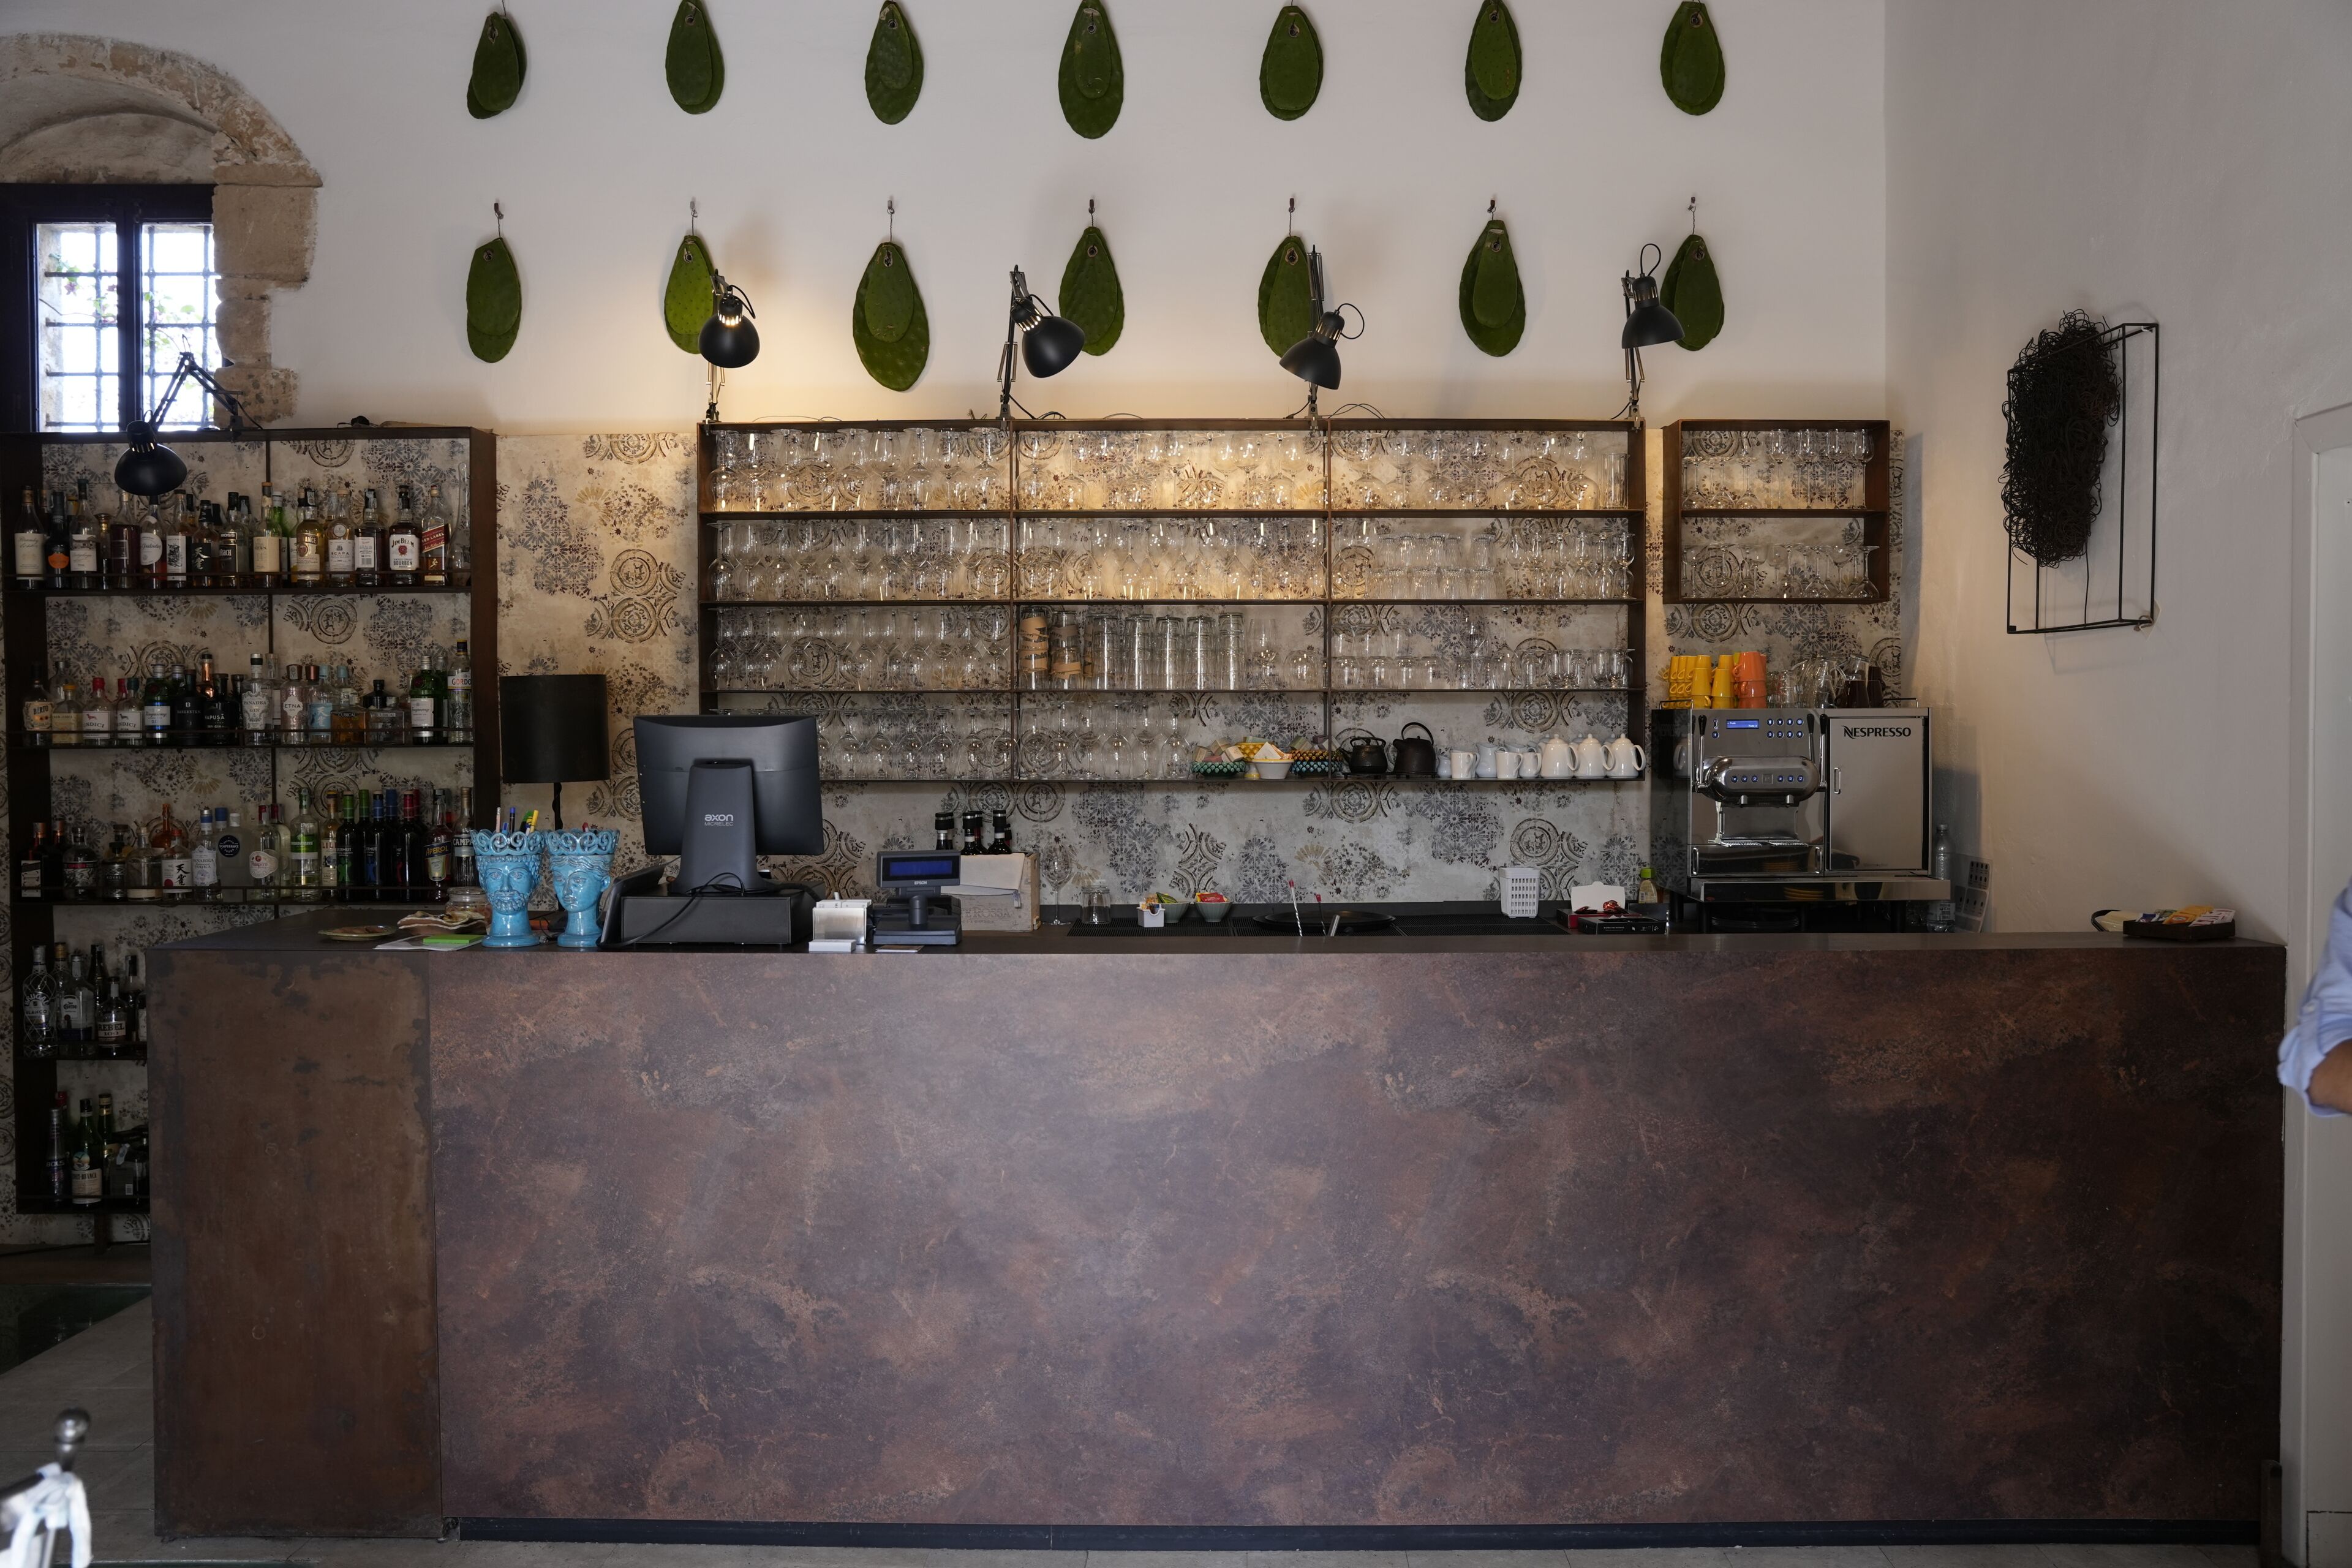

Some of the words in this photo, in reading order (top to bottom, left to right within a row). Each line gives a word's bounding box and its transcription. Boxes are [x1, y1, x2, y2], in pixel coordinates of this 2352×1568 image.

[401, 538, 414, 547] BEAM
[34, 705, 49, 715] BERTO
[1841, 725, 1911, 739] NESPRESSO
[453, 837, 473, 846] CAMPA
[426, 846, 449, 856] APEROL
[24, 993, 49, 1005] BRUGAL
